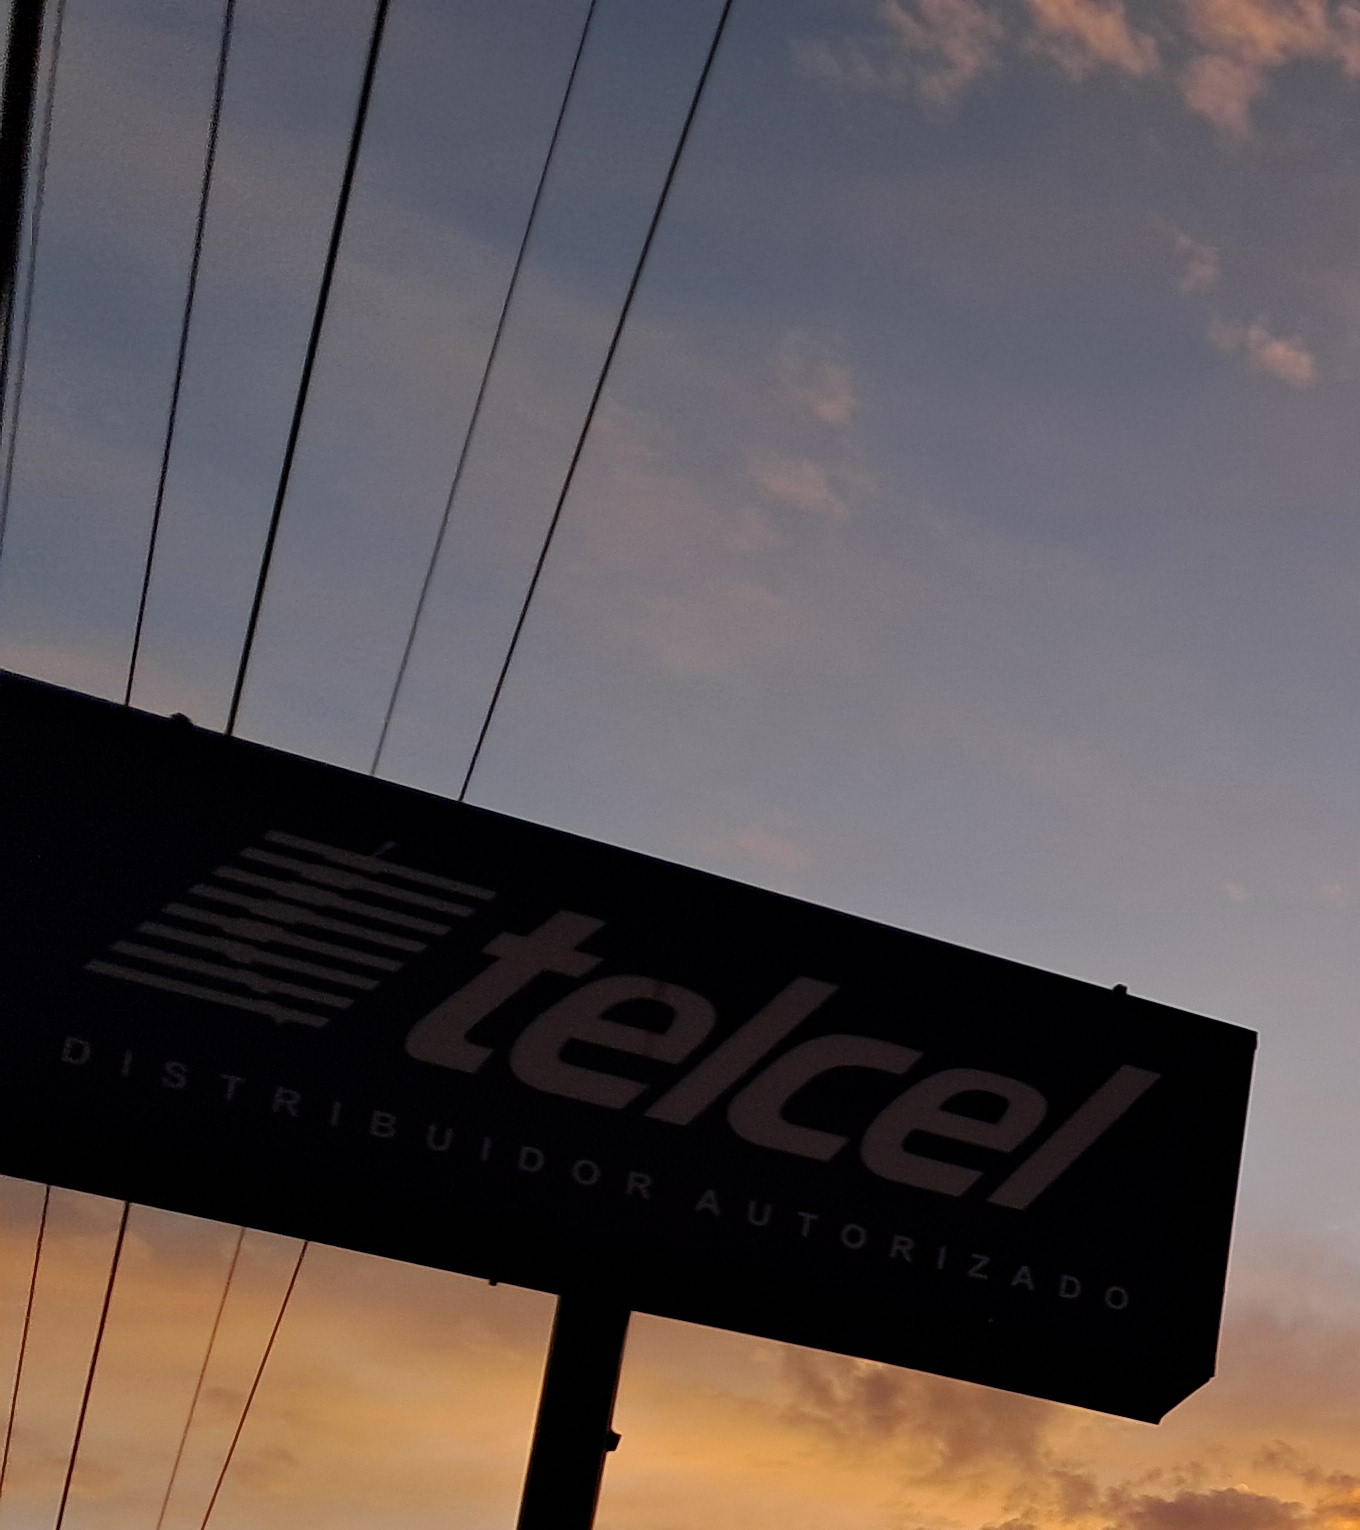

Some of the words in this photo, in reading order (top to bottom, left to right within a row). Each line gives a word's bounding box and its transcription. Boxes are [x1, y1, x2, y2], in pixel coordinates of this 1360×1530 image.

[61, 1036, 654, 1200] DISTRIBUIDOR
[695, 1190, 1131, 1311] AUTORIZADO
[404, 910, 1161, 1210] telcel
